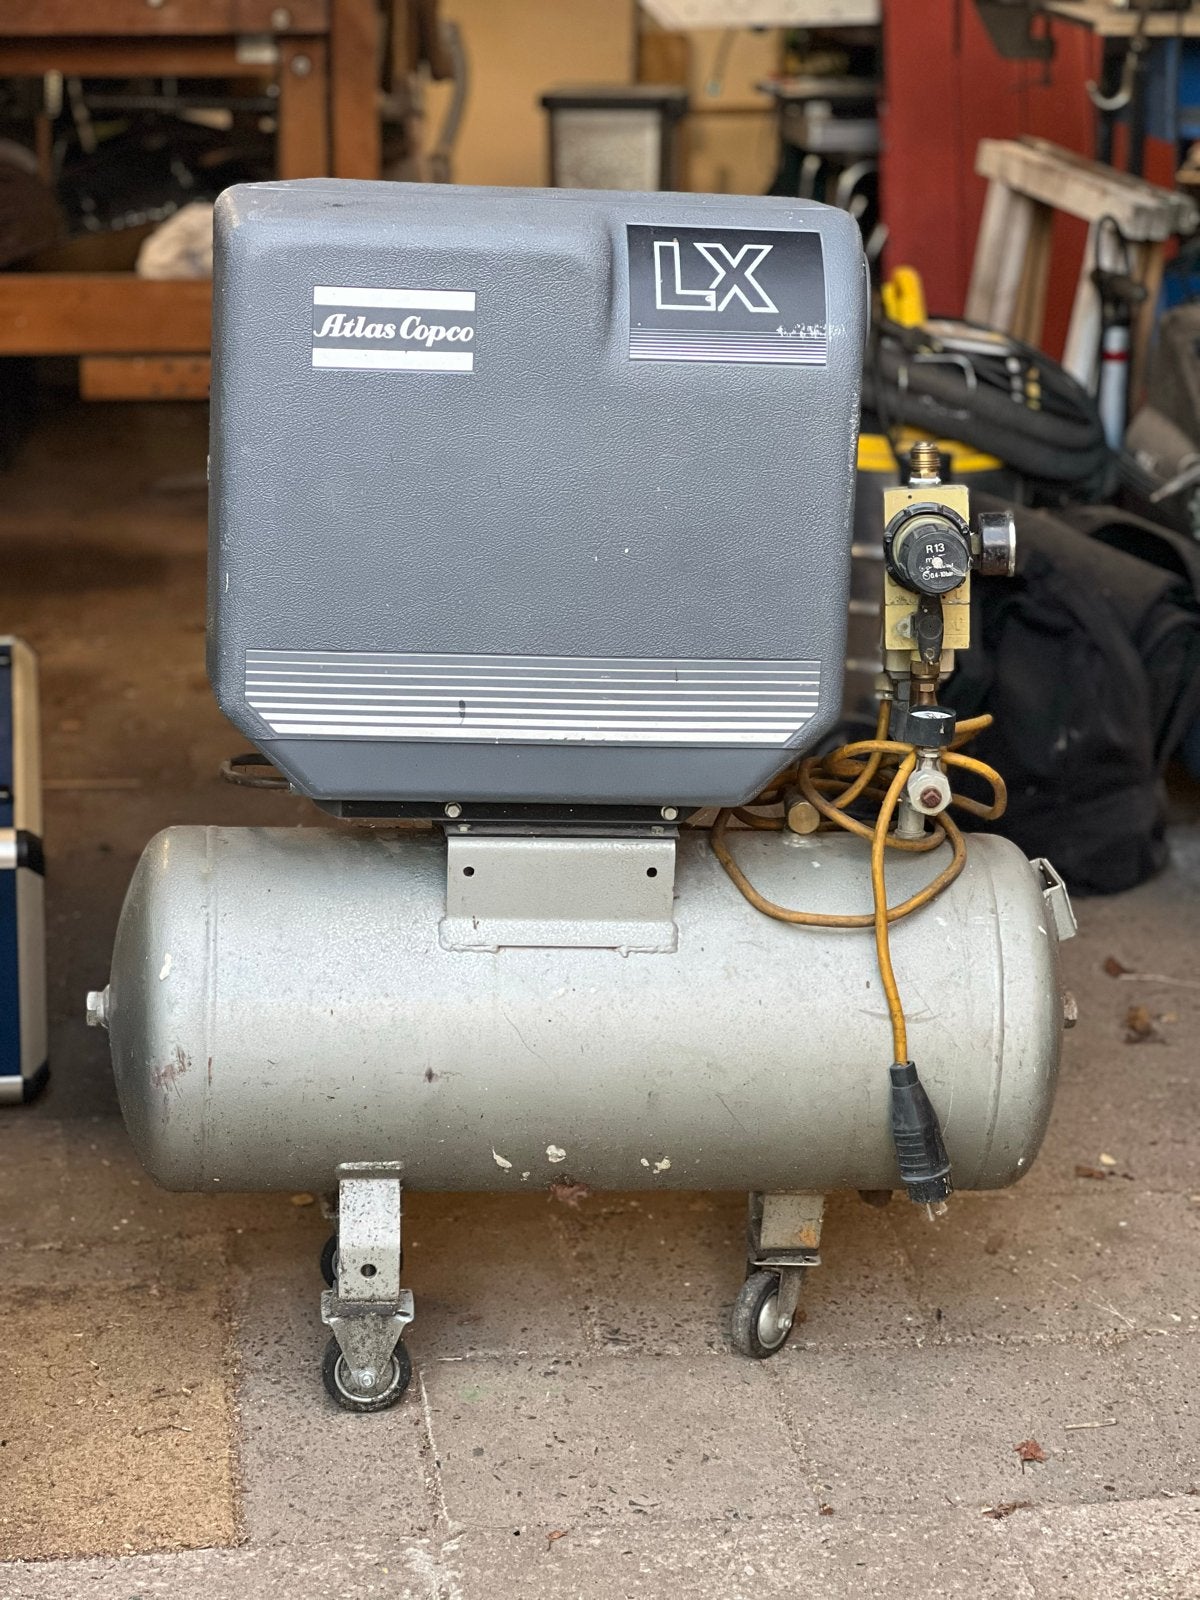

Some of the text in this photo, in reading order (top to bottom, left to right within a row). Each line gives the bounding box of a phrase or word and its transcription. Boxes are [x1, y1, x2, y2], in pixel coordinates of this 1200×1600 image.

[653, 240, 779, 314] LX
[313, 313, 474, 347] Atlas Copco
